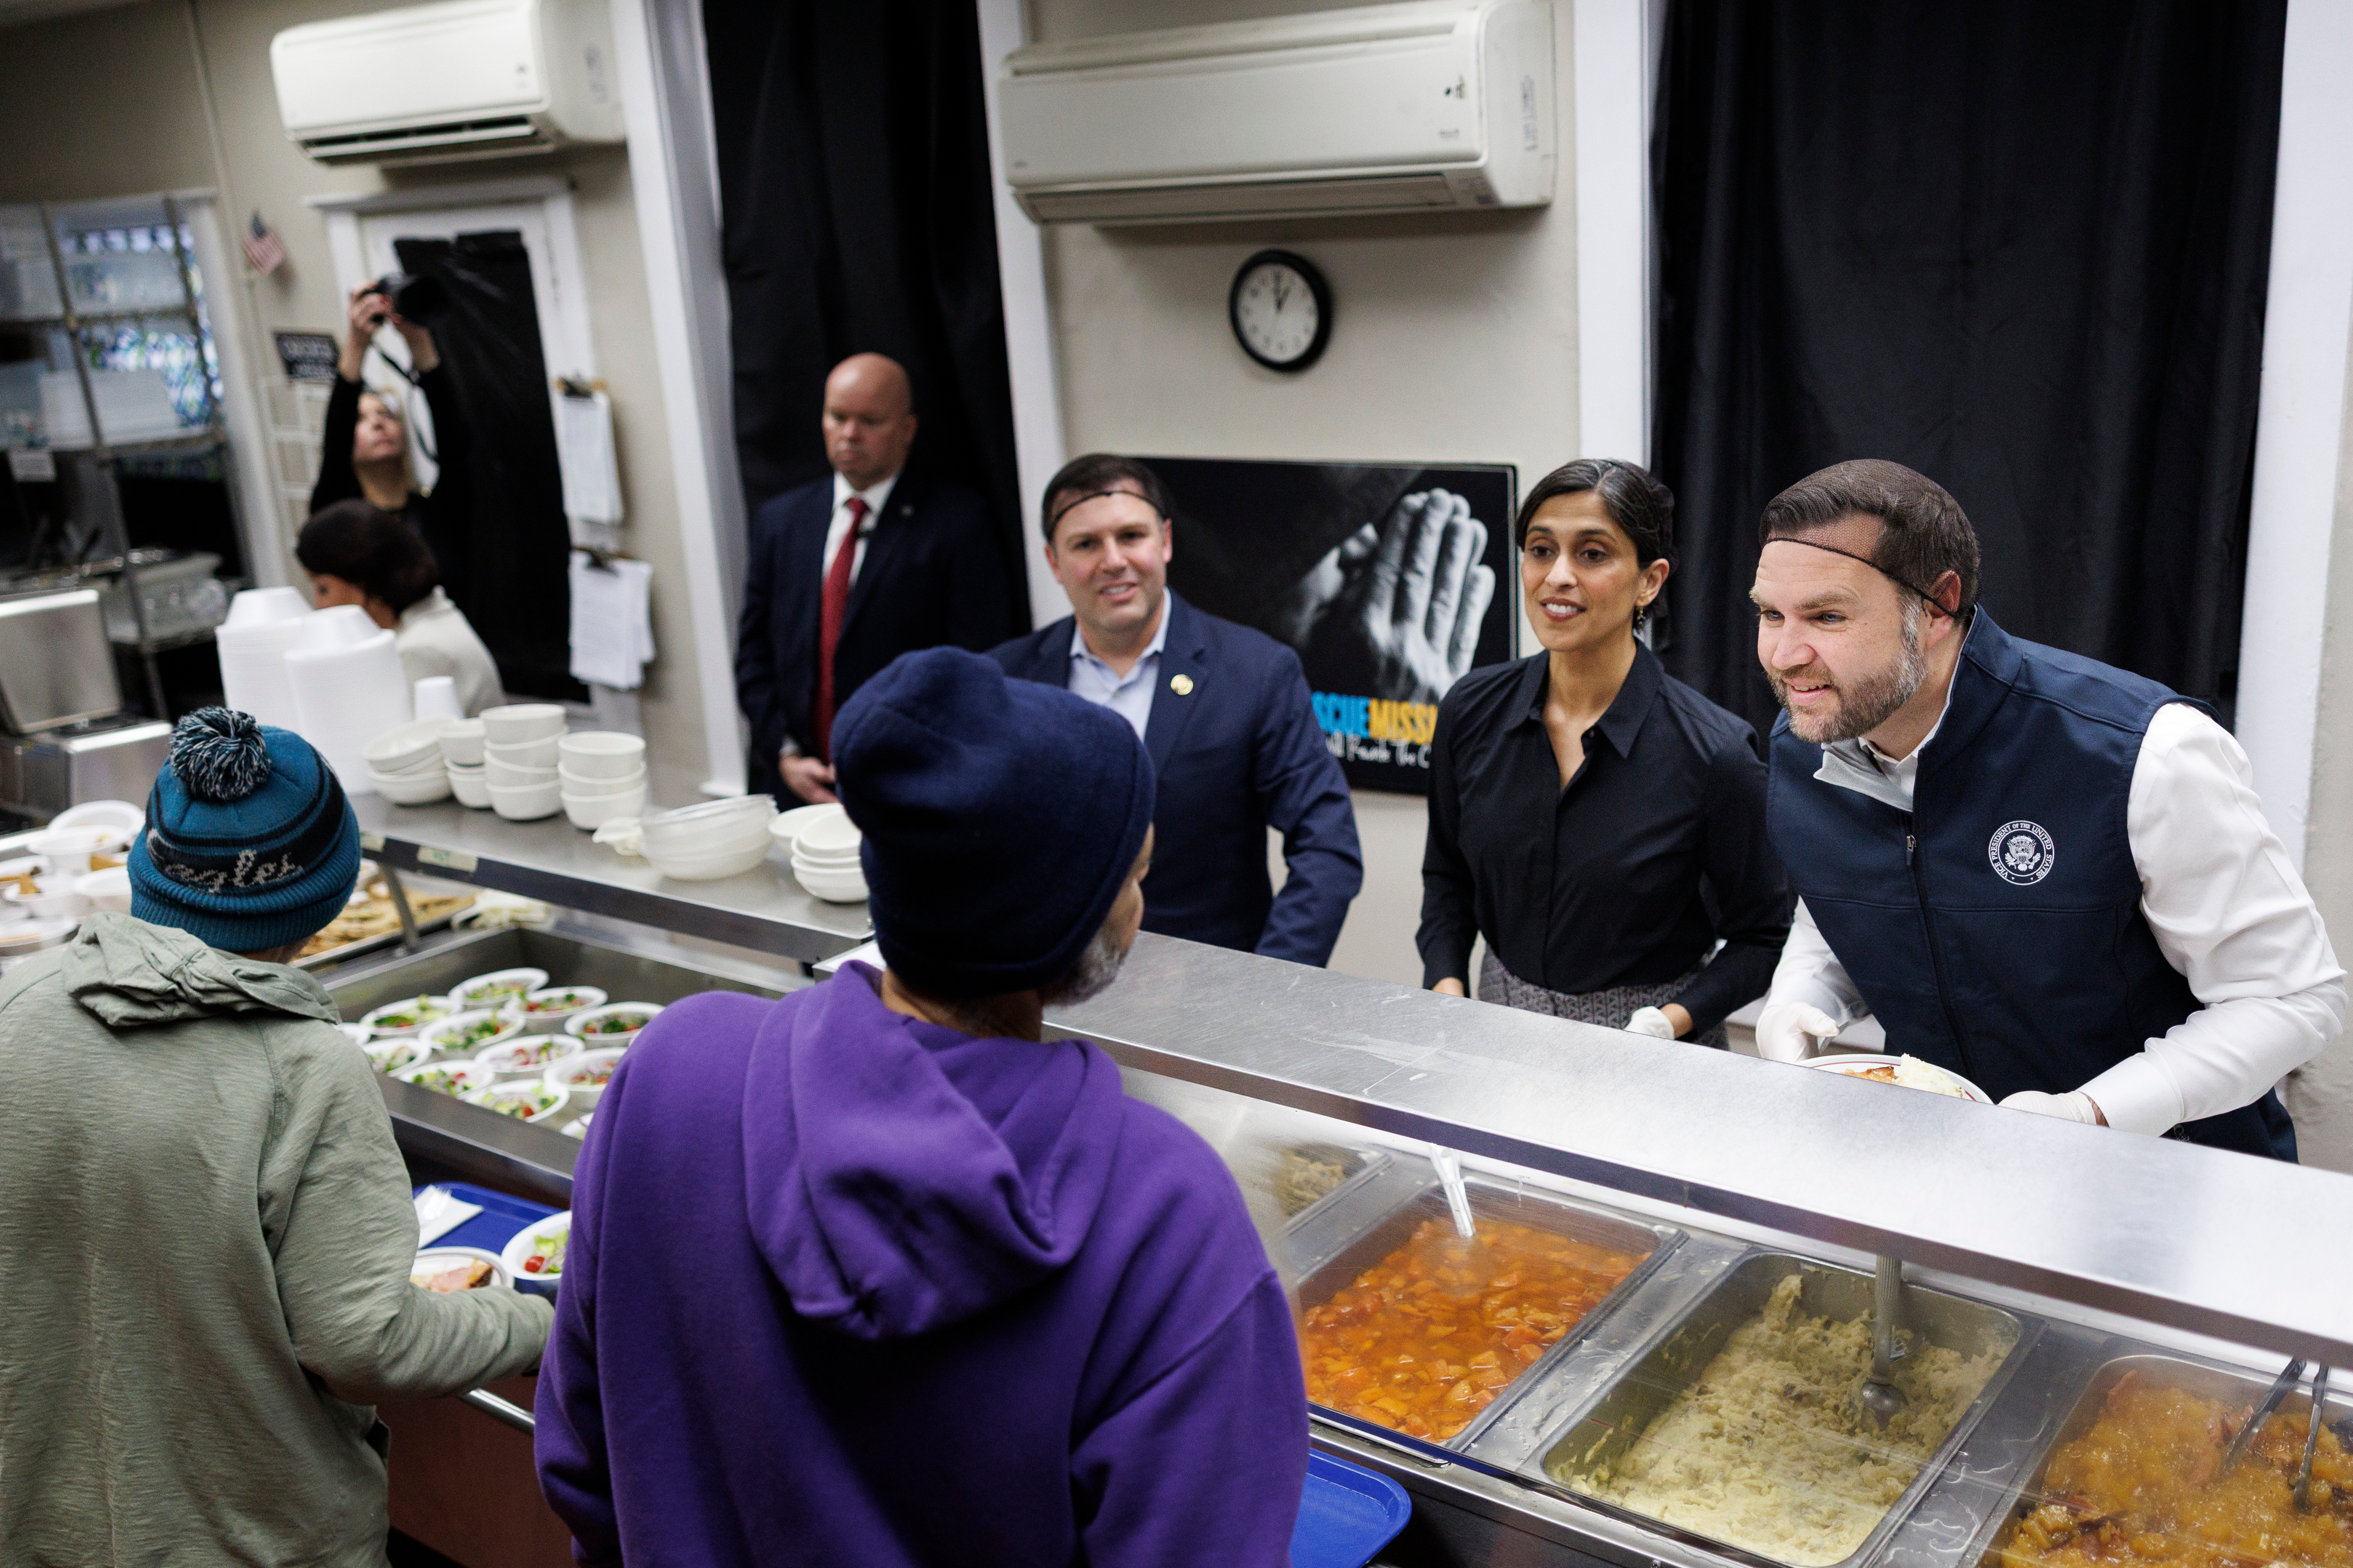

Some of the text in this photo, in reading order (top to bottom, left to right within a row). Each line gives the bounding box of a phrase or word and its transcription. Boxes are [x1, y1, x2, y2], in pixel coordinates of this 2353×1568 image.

[1991, 825, 2011, 861] PRESIDENT
[2032, 825, 2052, 850] UNITED
[1994, 862, 2008, 878] VICE
[2036, 854, 2052, 879] STATES
